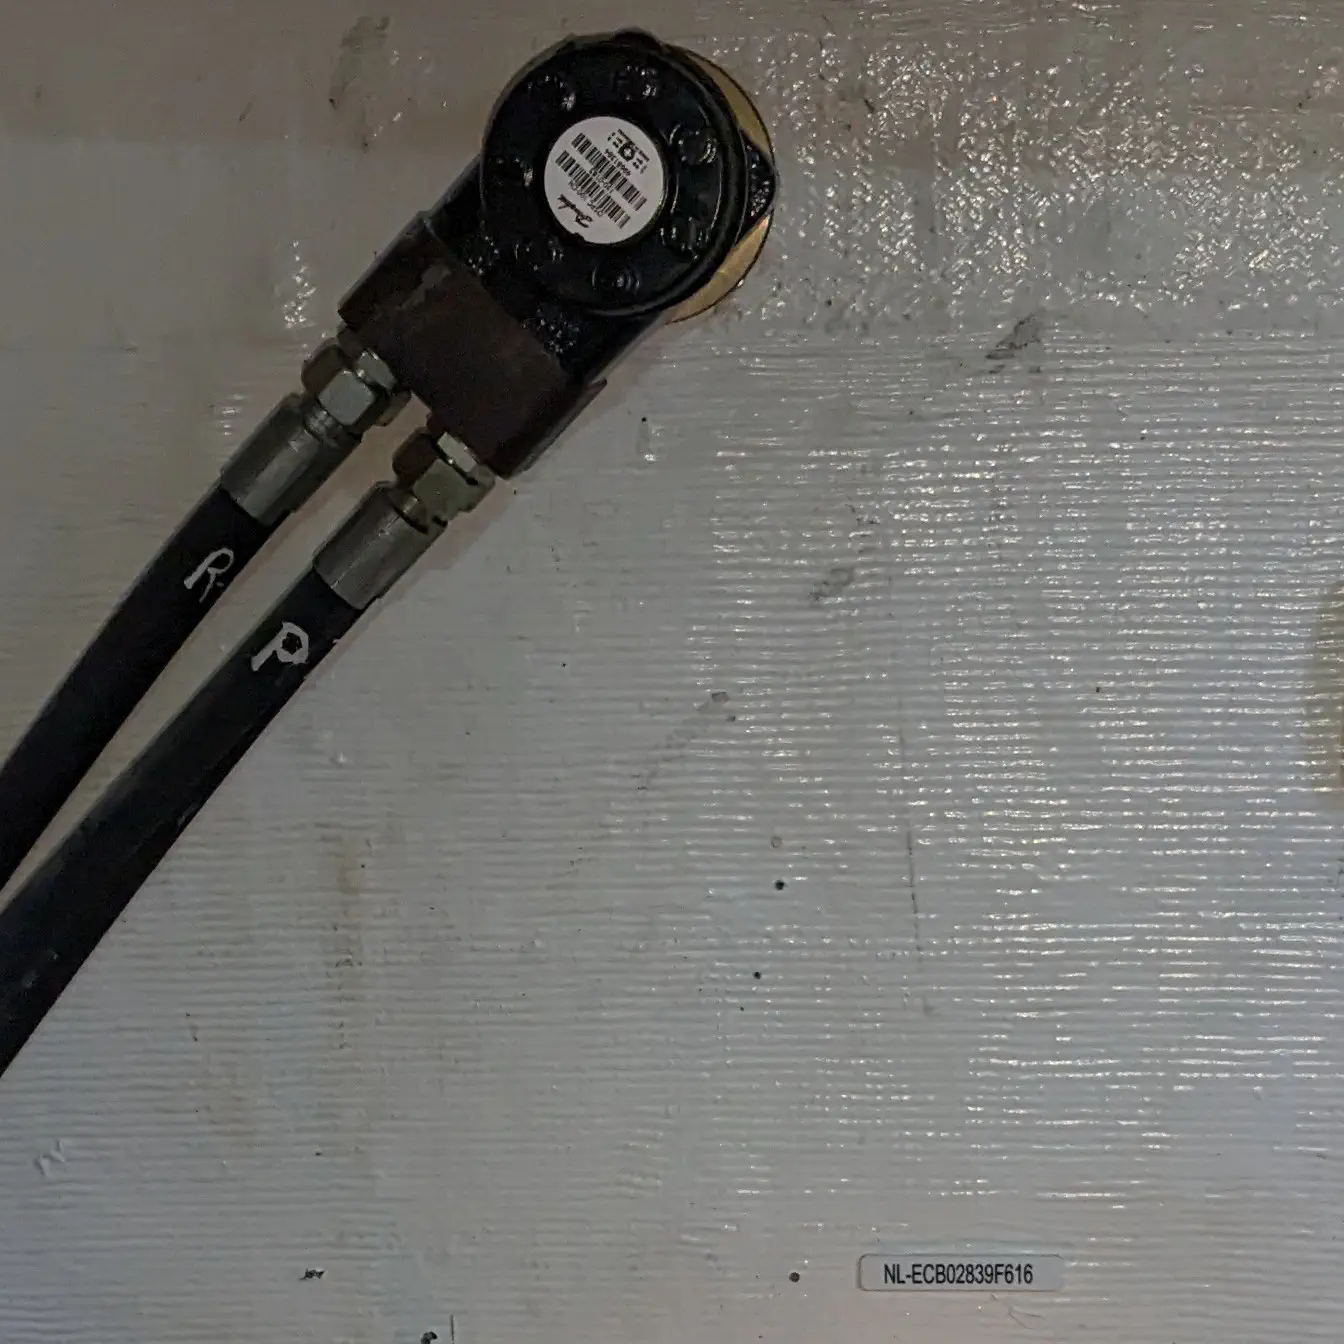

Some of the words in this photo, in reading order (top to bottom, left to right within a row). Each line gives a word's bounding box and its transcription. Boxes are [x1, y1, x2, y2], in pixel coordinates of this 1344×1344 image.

[183, 547, 234, 603] R
[251, 621, 309, 671] P
[883, 1263, 1034, 1285] NL-ECB02839F616
